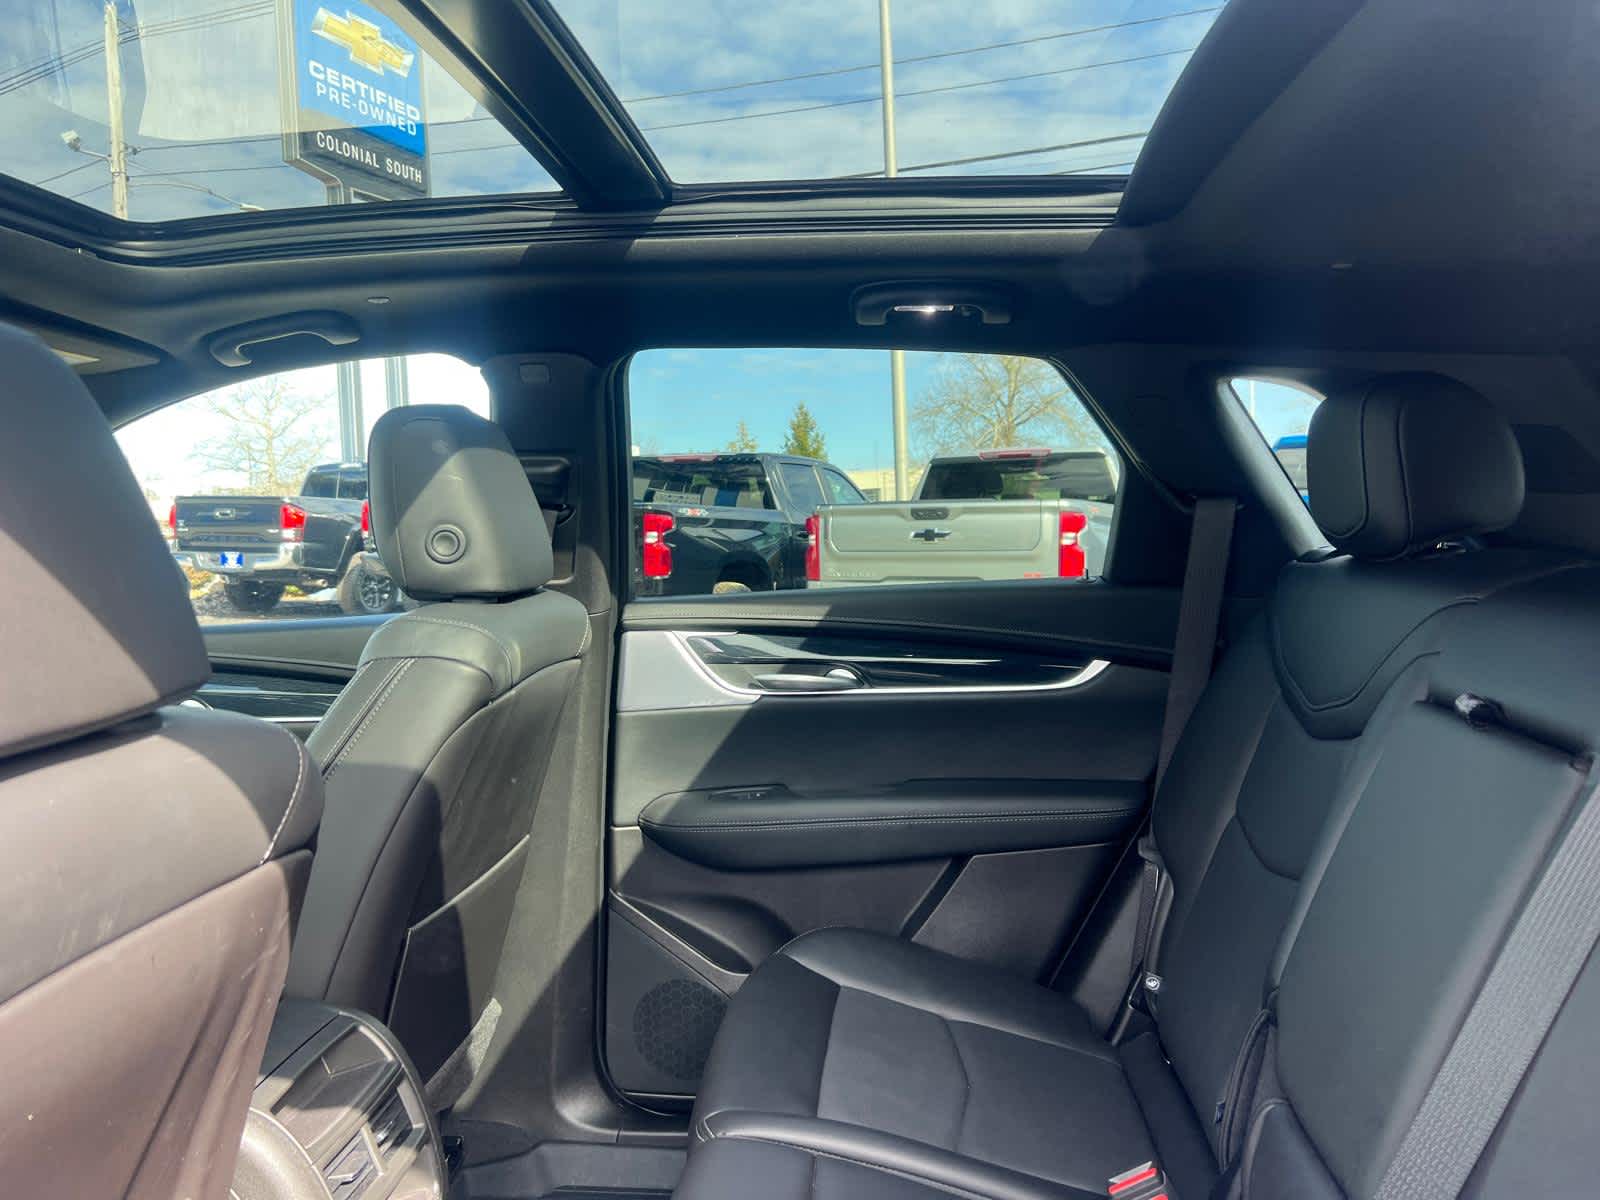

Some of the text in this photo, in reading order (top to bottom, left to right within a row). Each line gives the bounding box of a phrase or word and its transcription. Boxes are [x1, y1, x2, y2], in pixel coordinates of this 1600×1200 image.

[308, 60, 420, 121] CERTIFIED
[316, 82, 417, 136] PRE-OWNED
[316, 131, 422, 183] COLONIAL SOUTH
